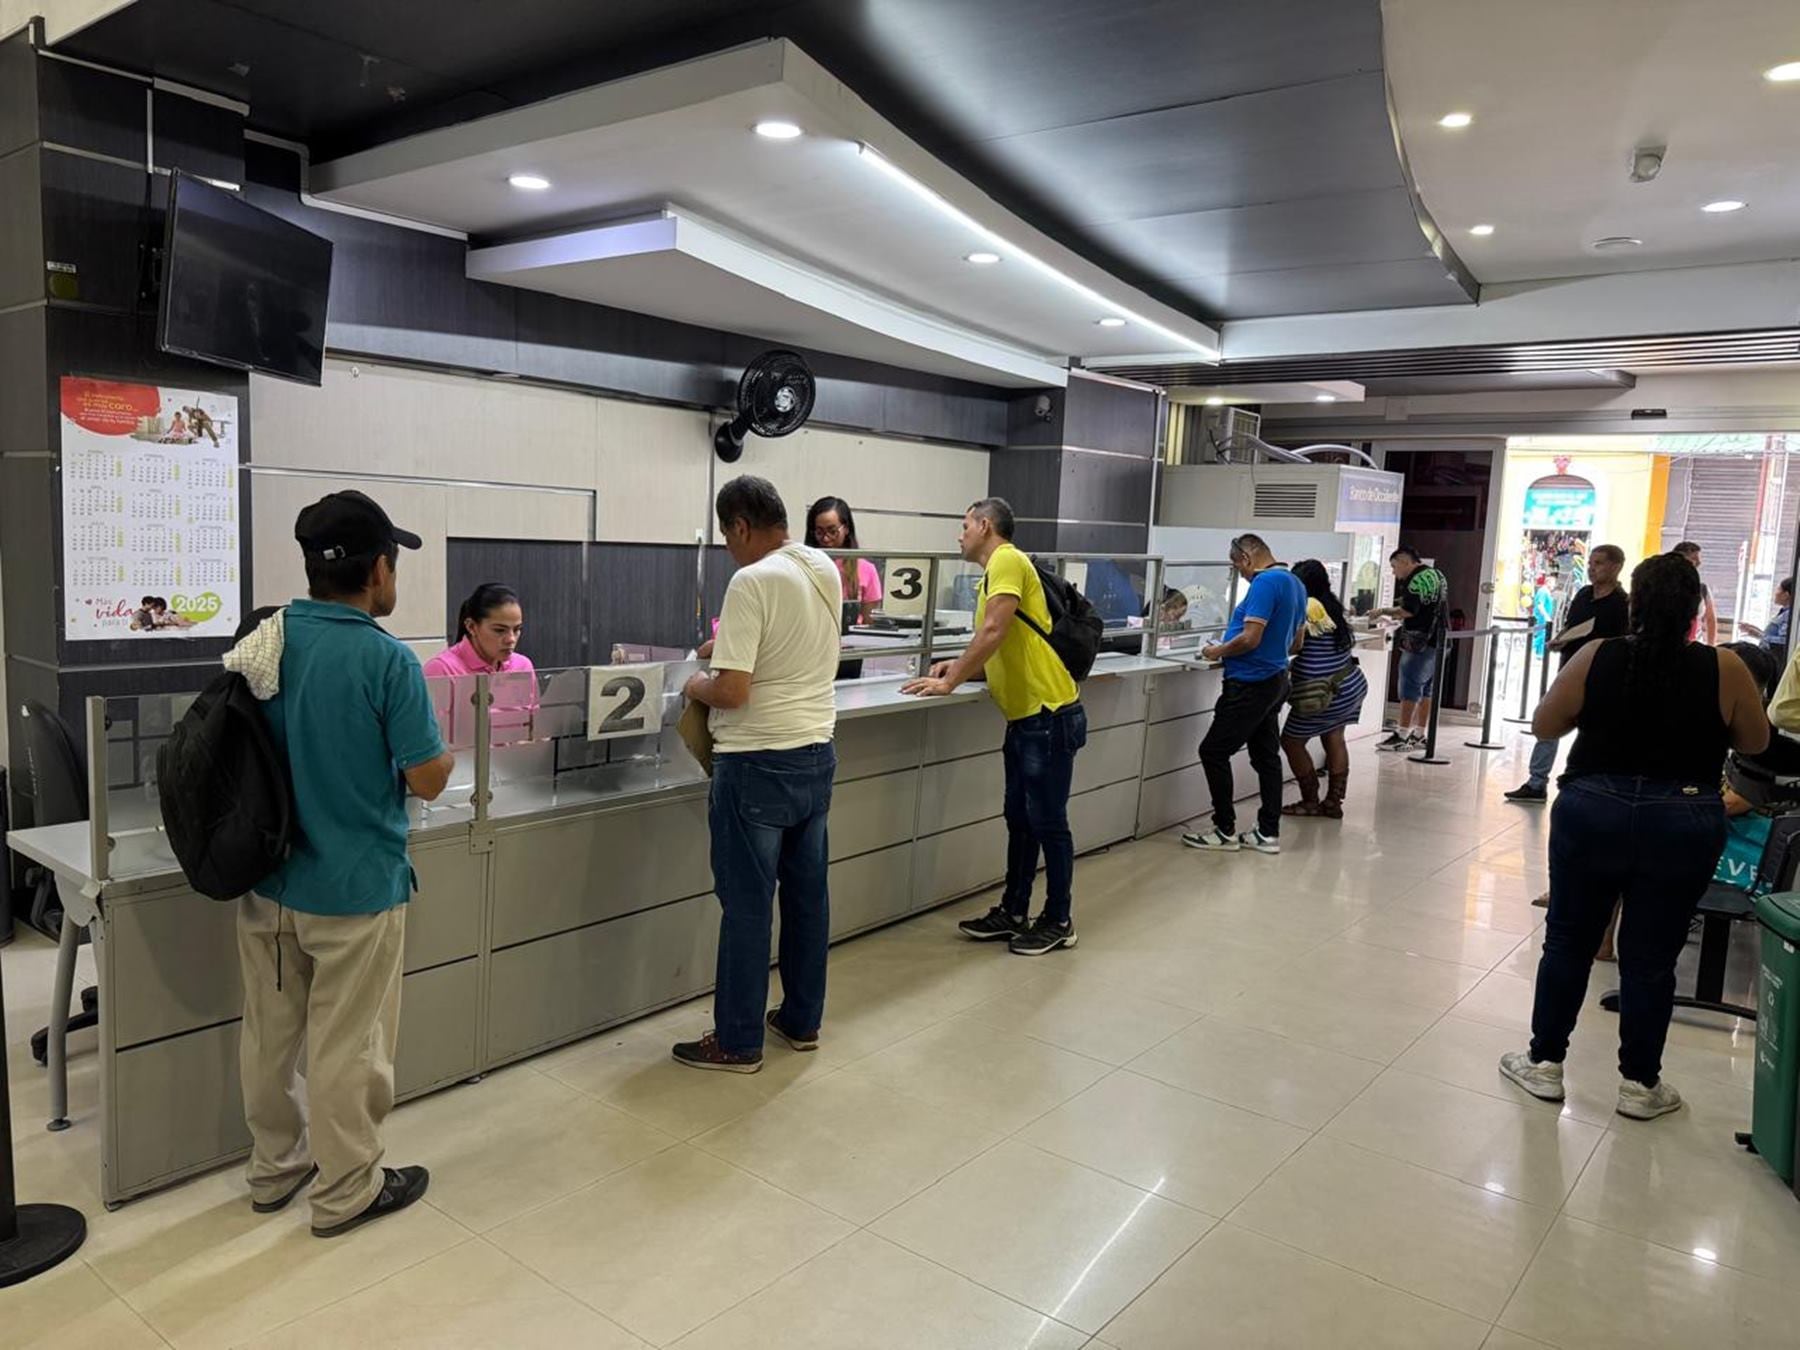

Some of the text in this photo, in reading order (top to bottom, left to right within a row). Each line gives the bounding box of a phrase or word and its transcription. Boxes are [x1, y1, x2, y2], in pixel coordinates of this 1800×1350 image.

[890, 567, 923, 600] 3
[95, 599, 134, 620] vida
[176, 597, 219, 612] 2025
[598, 675, 646, 734] 2
